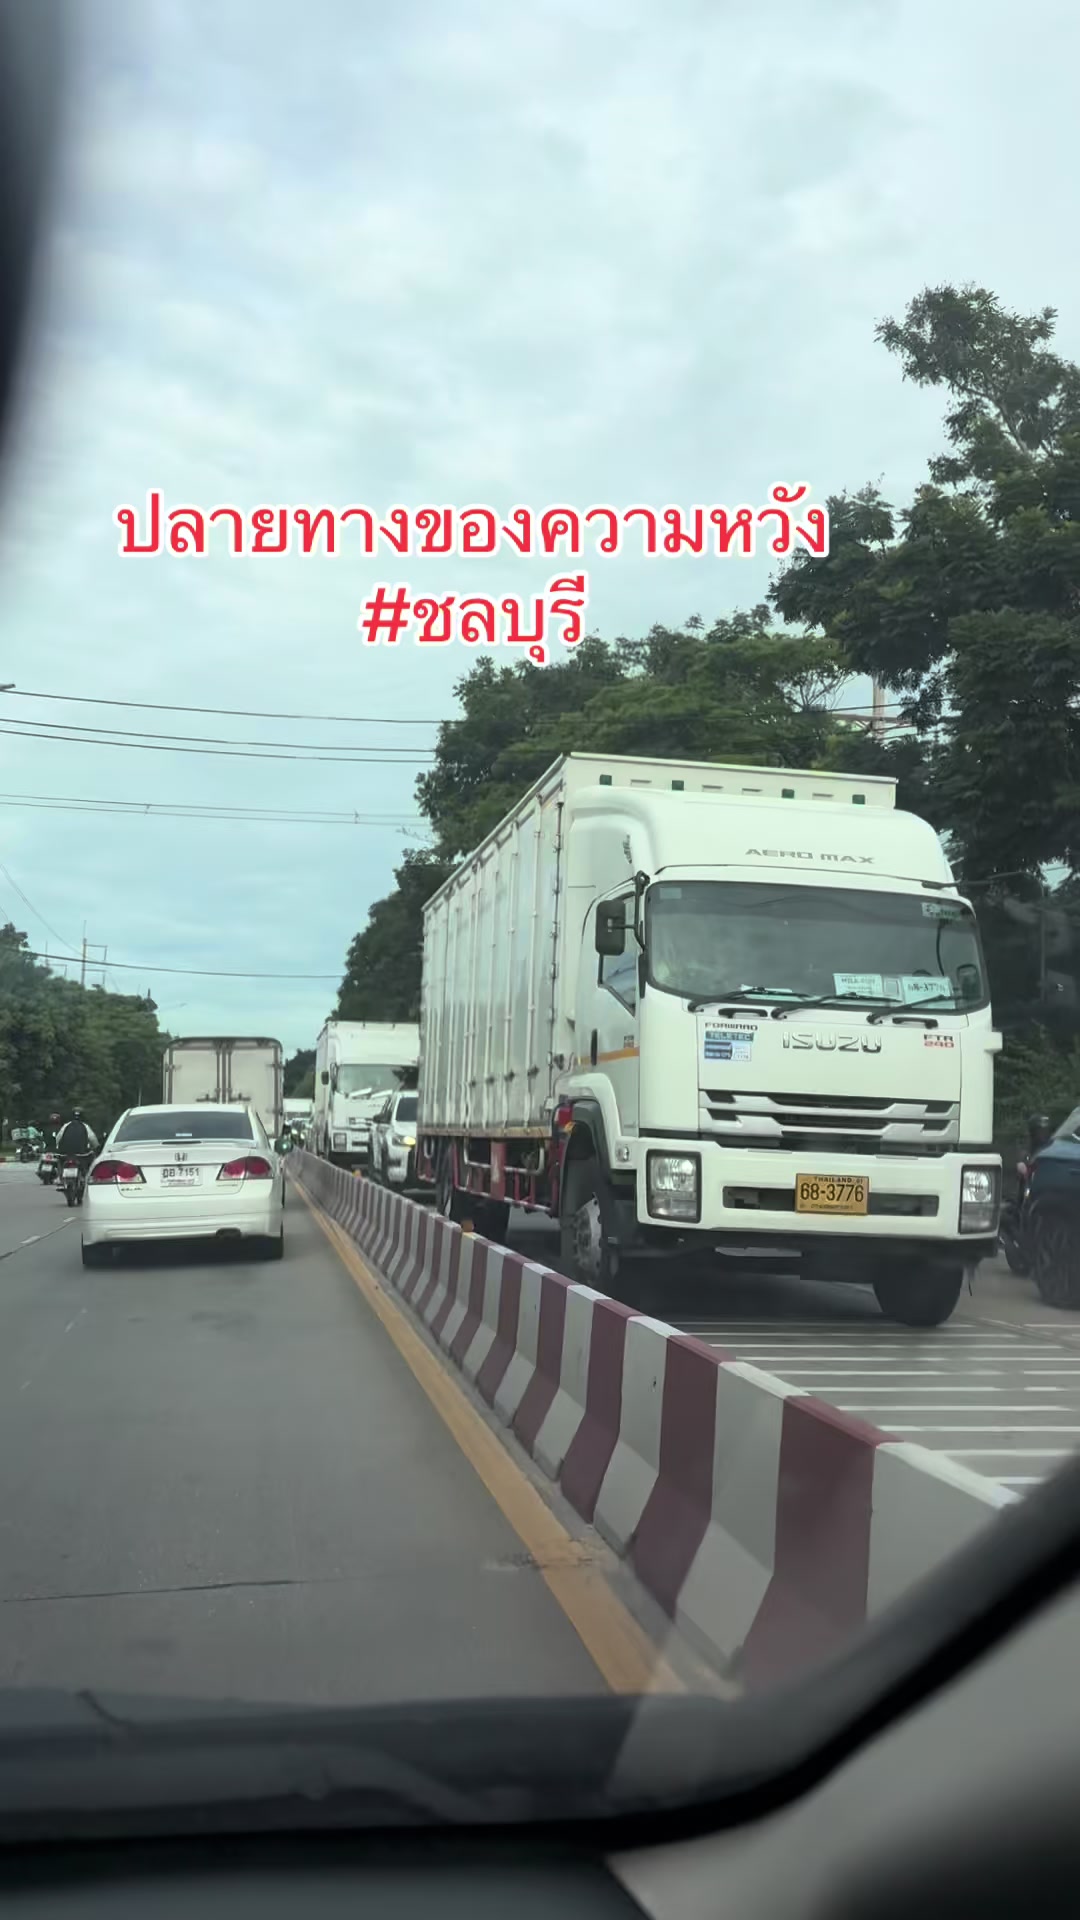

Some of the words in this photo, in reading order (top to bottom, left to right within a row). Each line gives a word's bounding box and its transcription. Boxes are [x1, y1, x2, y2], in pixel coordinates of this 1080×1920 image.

[745, 848, 813, 859] AERO
[820, 853, 875, 864] MAX
[782, 1031, 882, 1053] ISUZU
[923, 1033, 954, 1042] FTR
[800, 1182, 864, 1203] 68-3776
